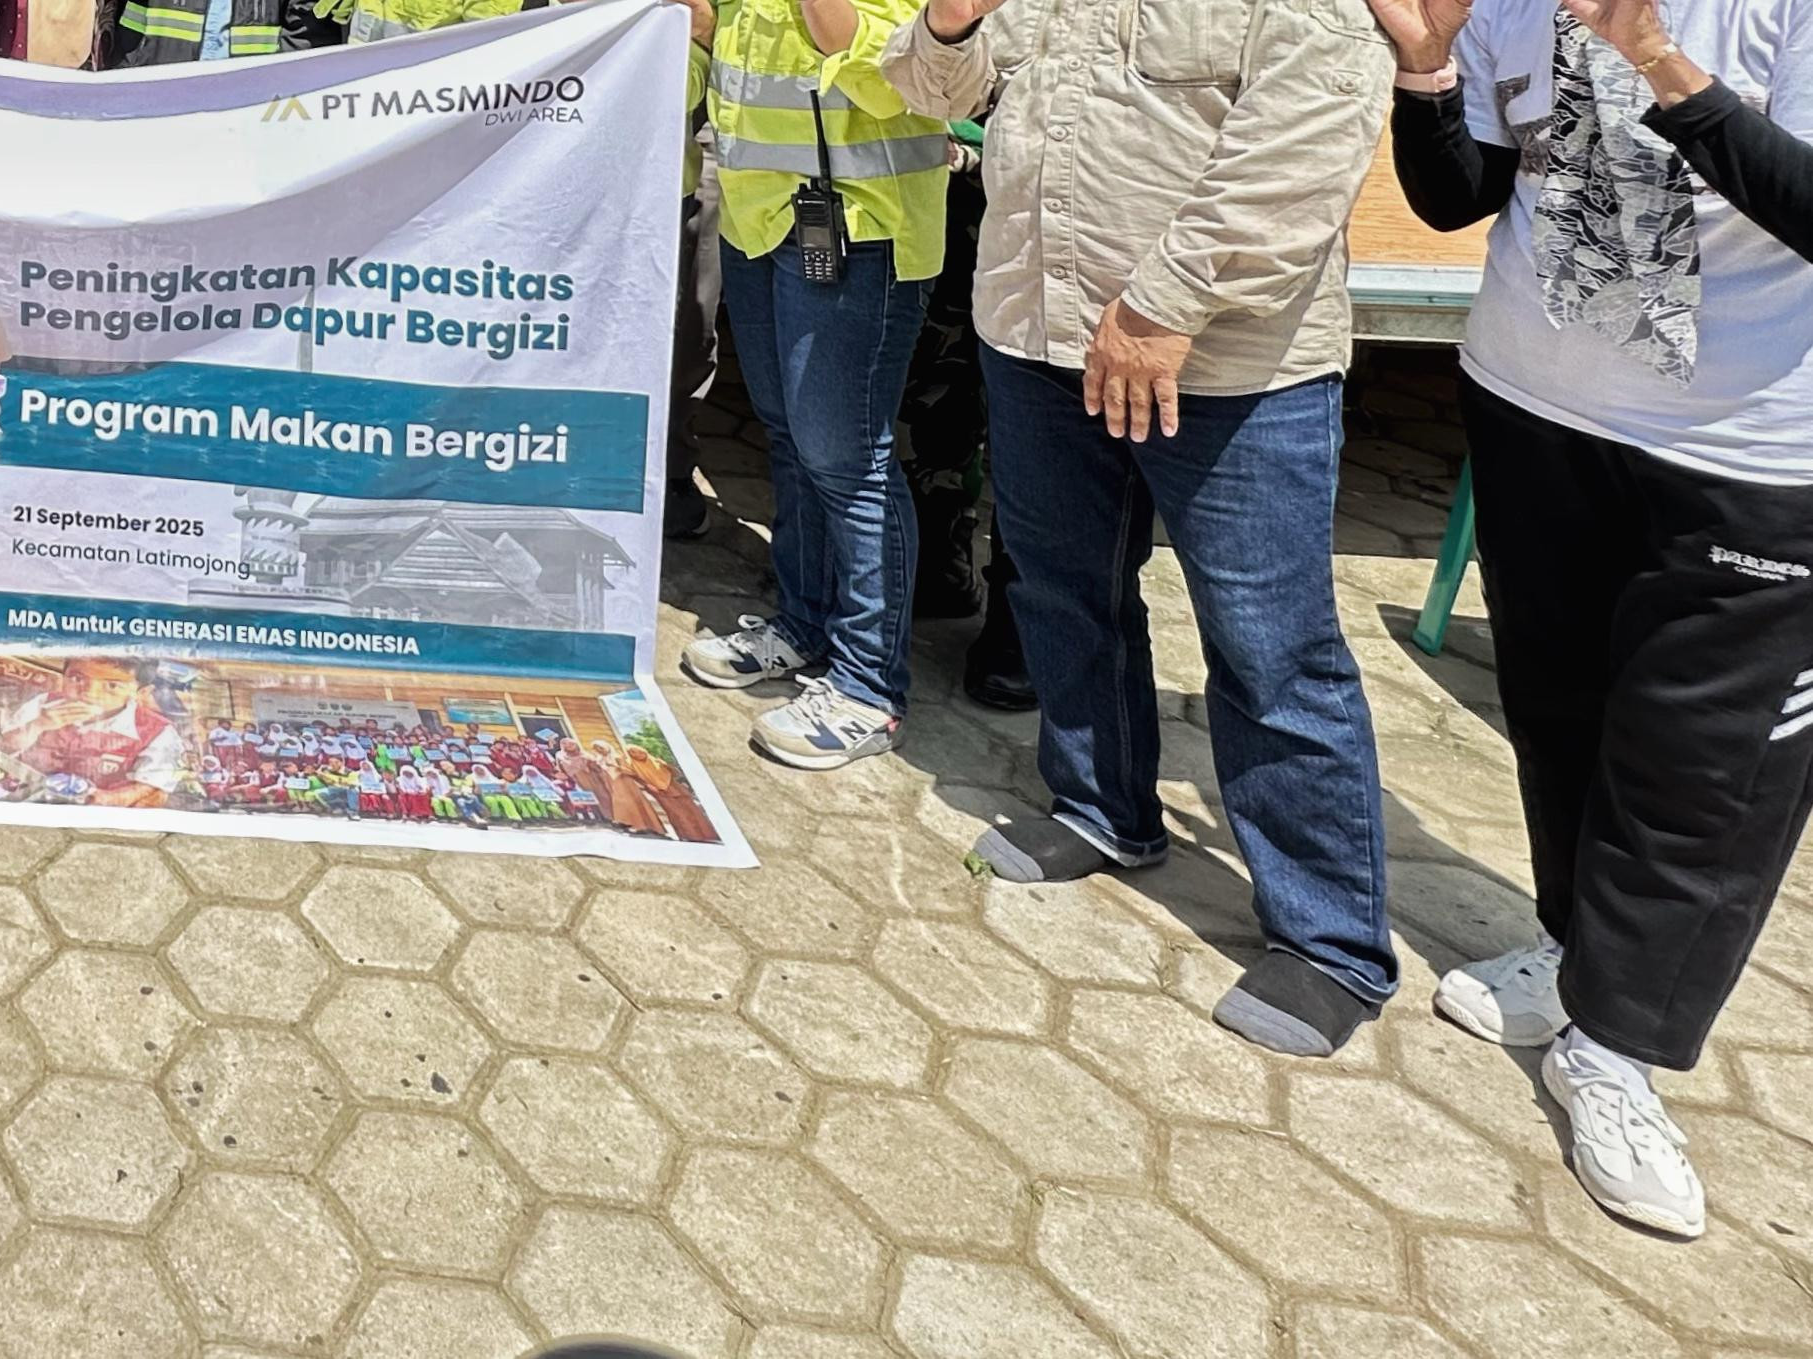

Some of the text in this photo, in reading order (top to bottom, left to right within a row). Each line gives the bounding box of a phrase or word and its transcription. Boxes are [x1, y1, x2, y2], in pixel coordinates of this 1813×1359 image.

[322, 75, 585, 119] PT MASMINDO
[484, 106, 584, 126] DWI AREA
[20, 256, 574, 302] Peningkatan Kapasitas
[20, 301, 570, 360] Pengelola Dapur Bergizi
[20, 389, 569, 472] Program Makan Bergizi
[13, 506, 204, 537] 21 September 2025
[12, 538, 251, 580] Kecamatan Latimojong
[7, 608, 420, 656] MDA untuk GENERASI EMAS INDONESIA
